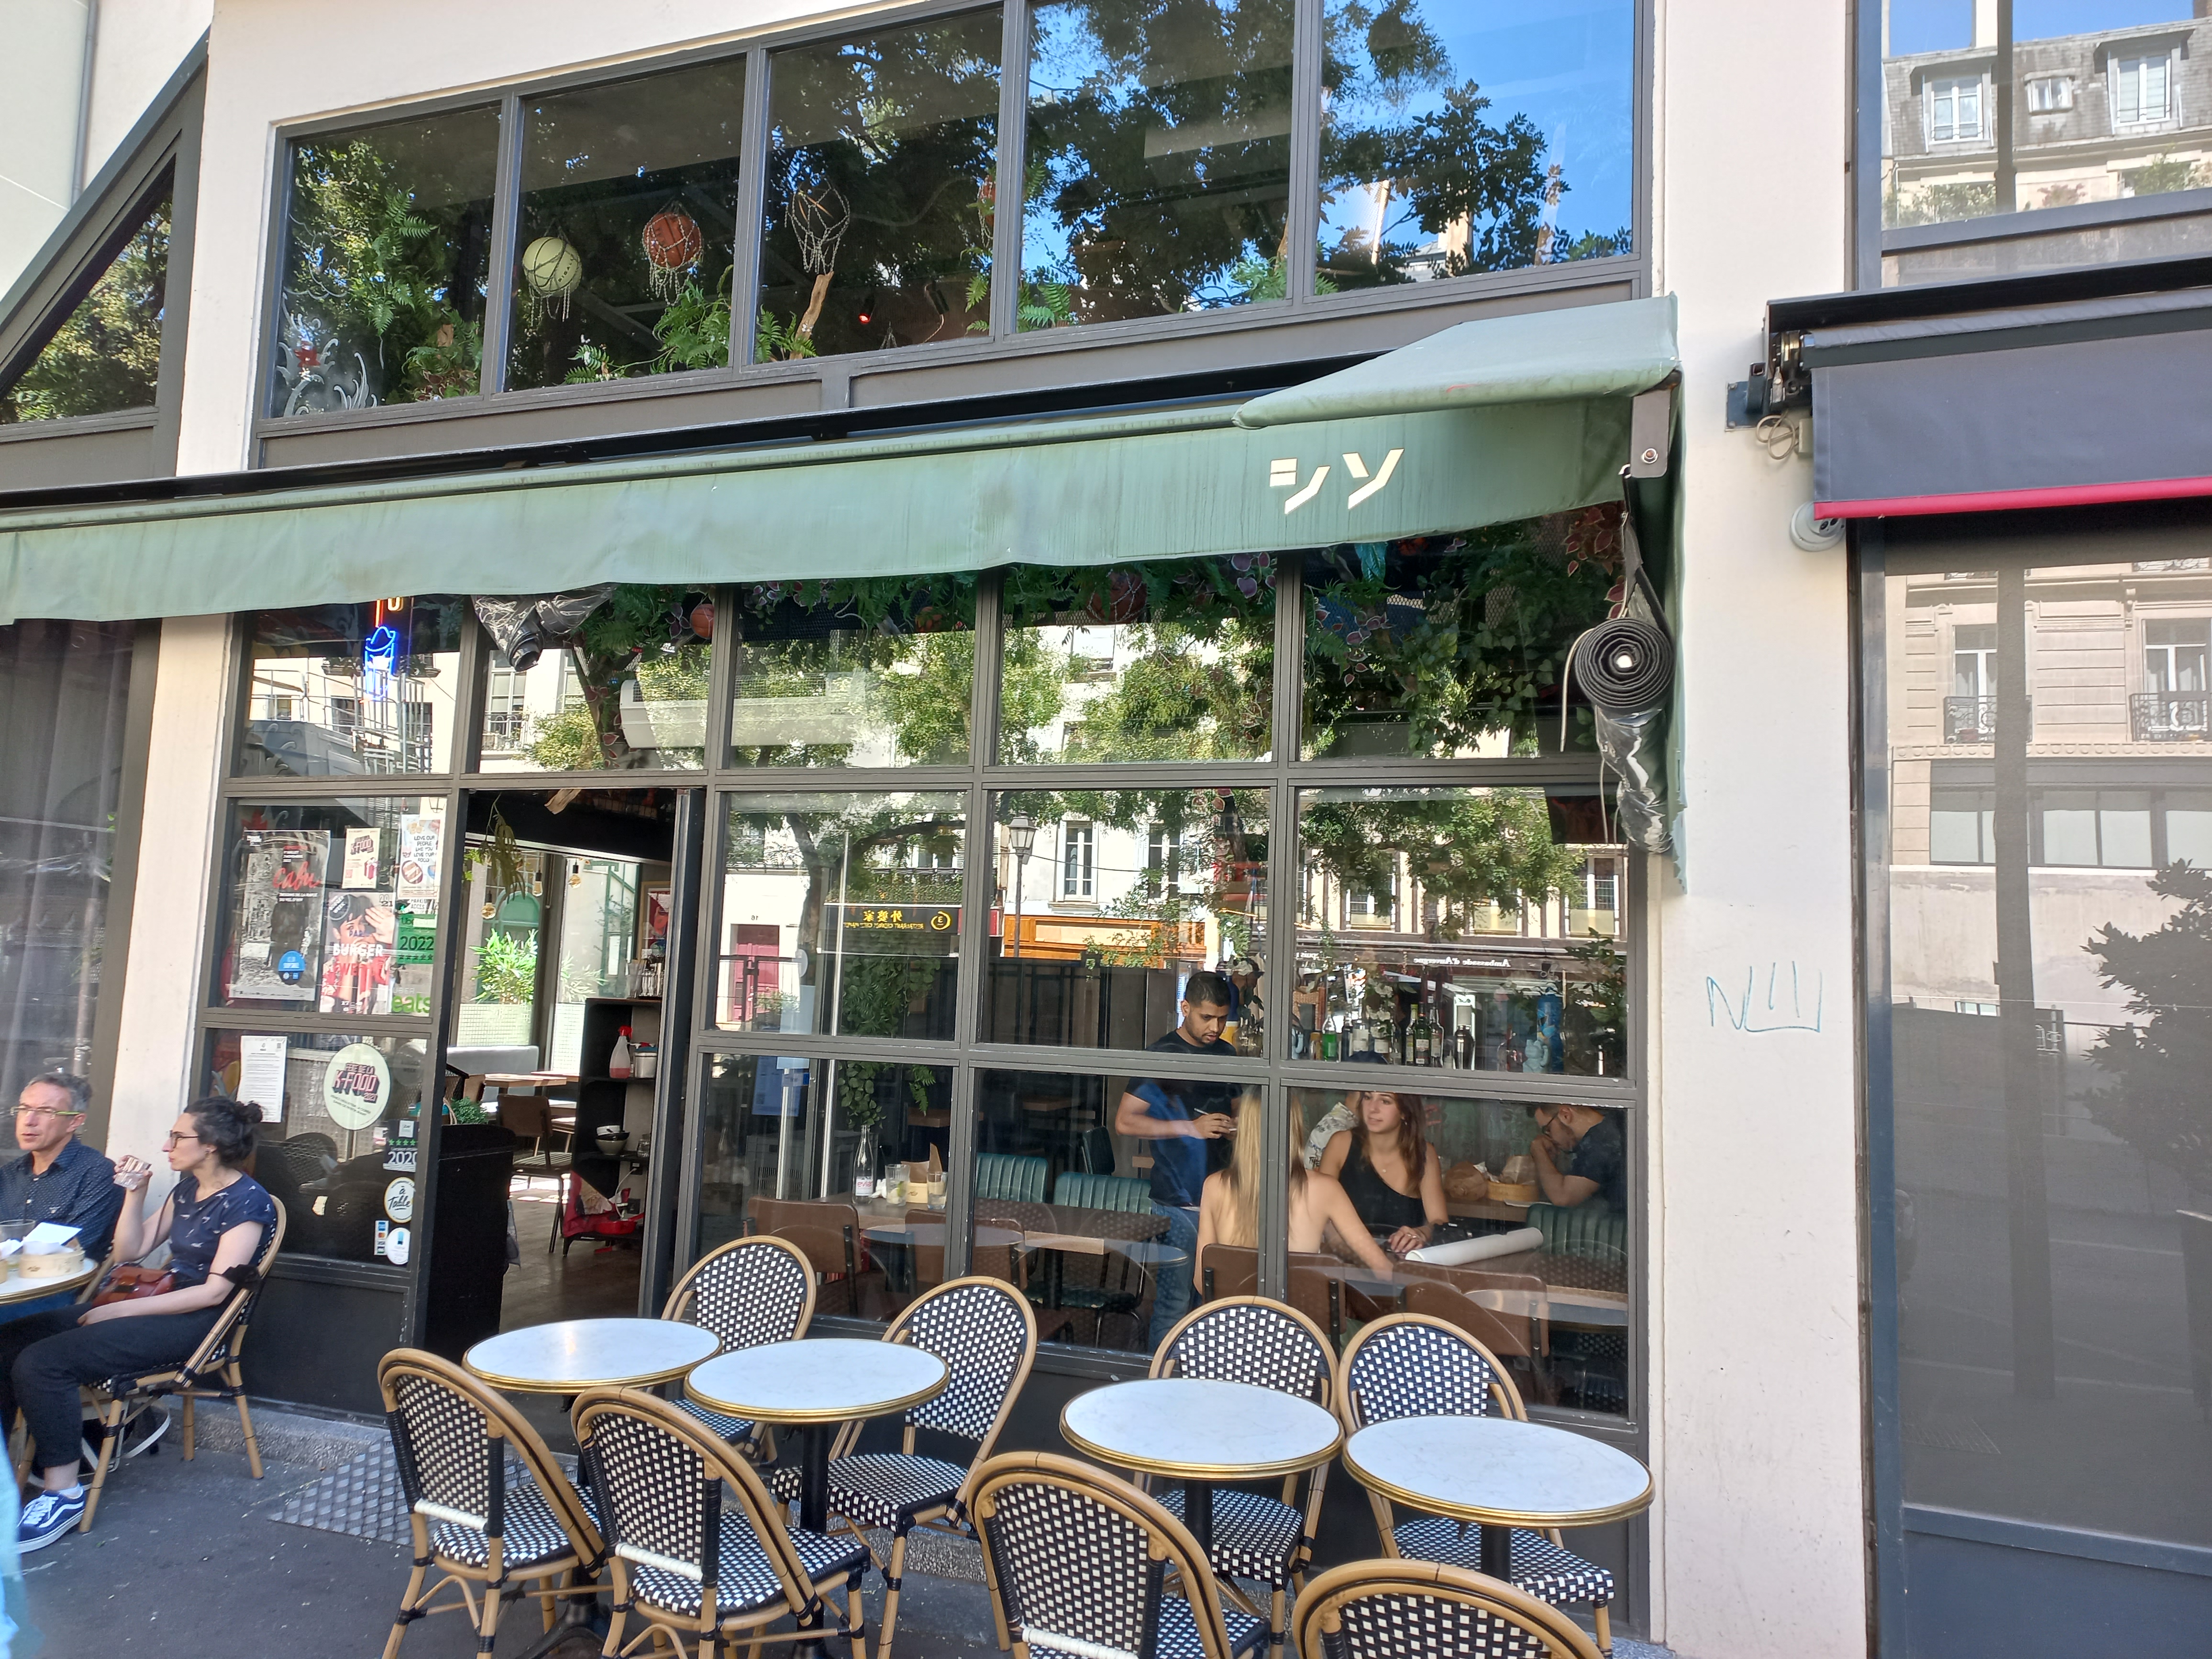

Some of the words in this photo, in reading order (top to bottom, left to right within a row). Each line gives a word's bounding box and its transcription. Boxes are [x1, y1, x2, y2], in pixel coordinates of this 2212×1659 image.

[333, 943, 384, 958] BURGER
[399, 936, 434, 951] 2022
[391, 993, 431, 1013] eats
[332, 1069, 379, 1095] K-FOOD
[399, 1186, 406, 1194] à
[387, 1195, 411, 1210] Table
